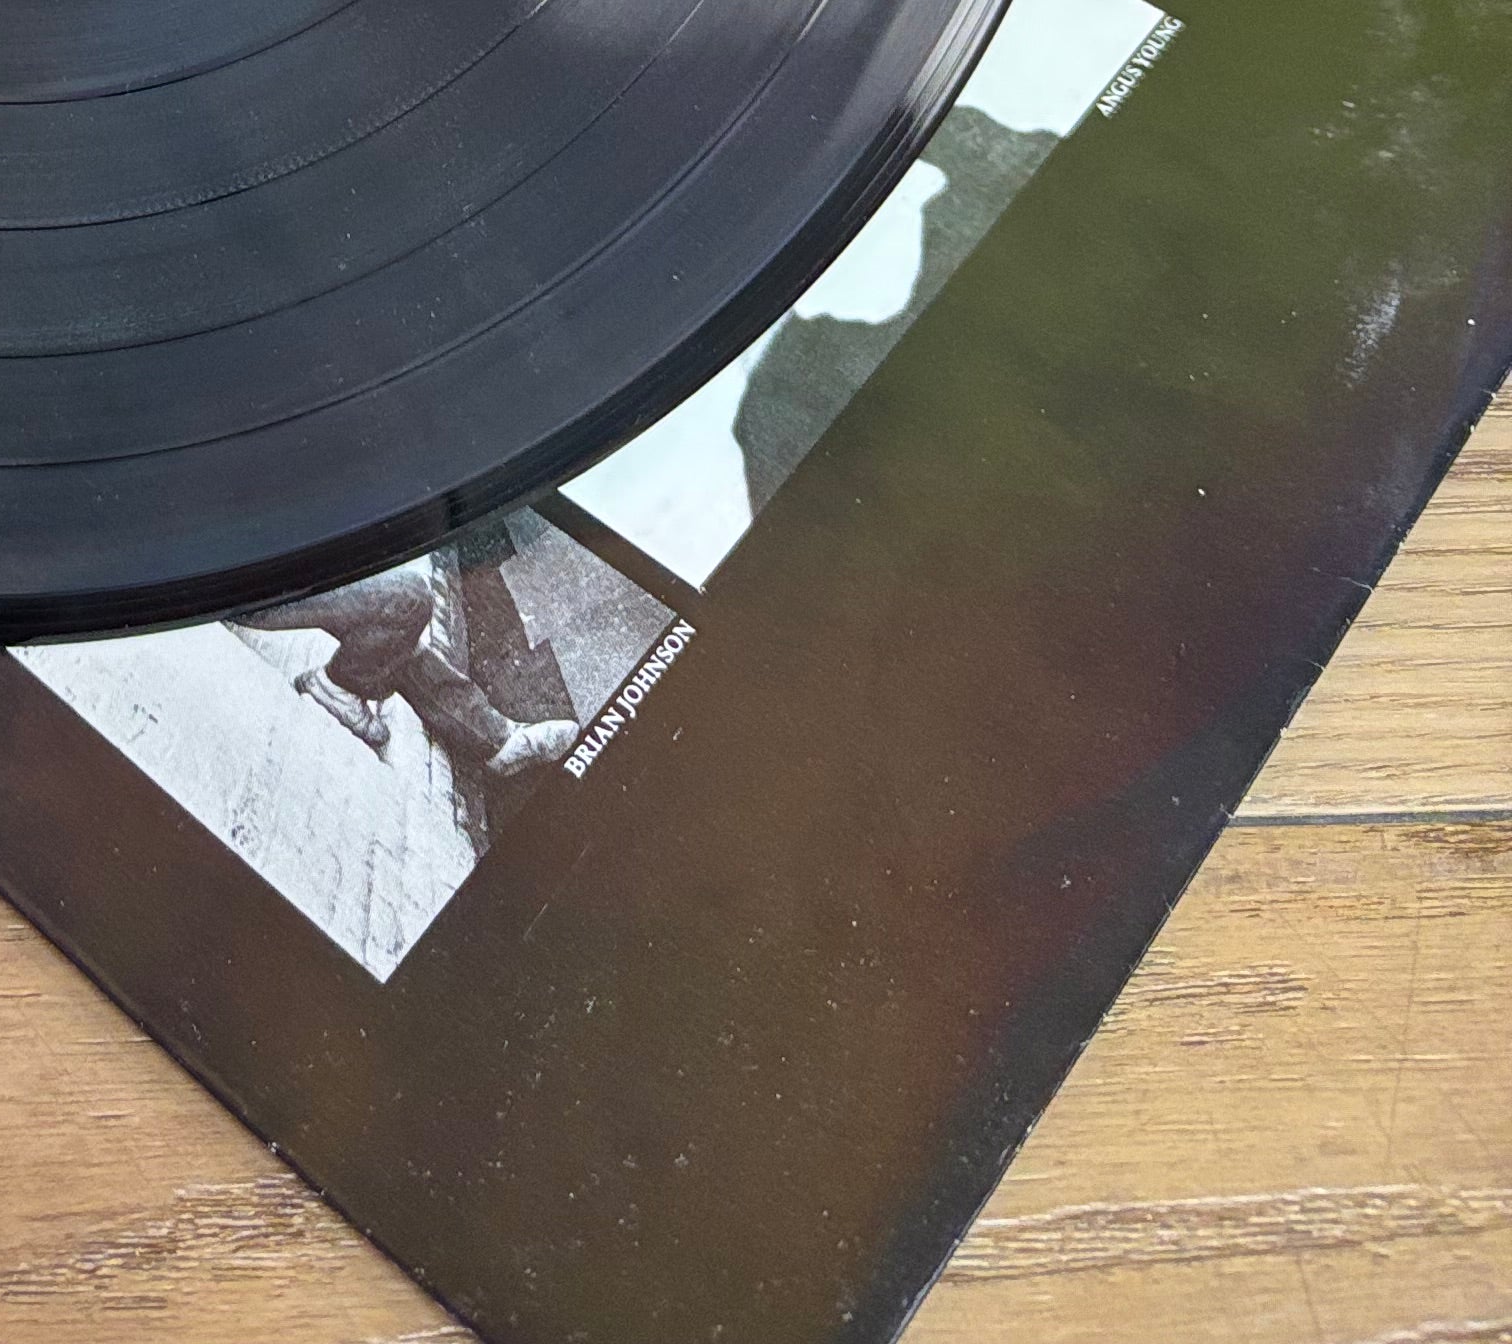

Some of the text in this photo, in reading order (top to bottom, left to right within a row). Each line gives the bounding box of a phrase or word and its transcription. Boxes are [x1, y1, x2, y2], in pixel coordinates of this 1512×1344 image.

[1095, 14, 1187, 120] ANGUS YOUNG
[563, 618, 696, 779] BRIAN JOHNSON
